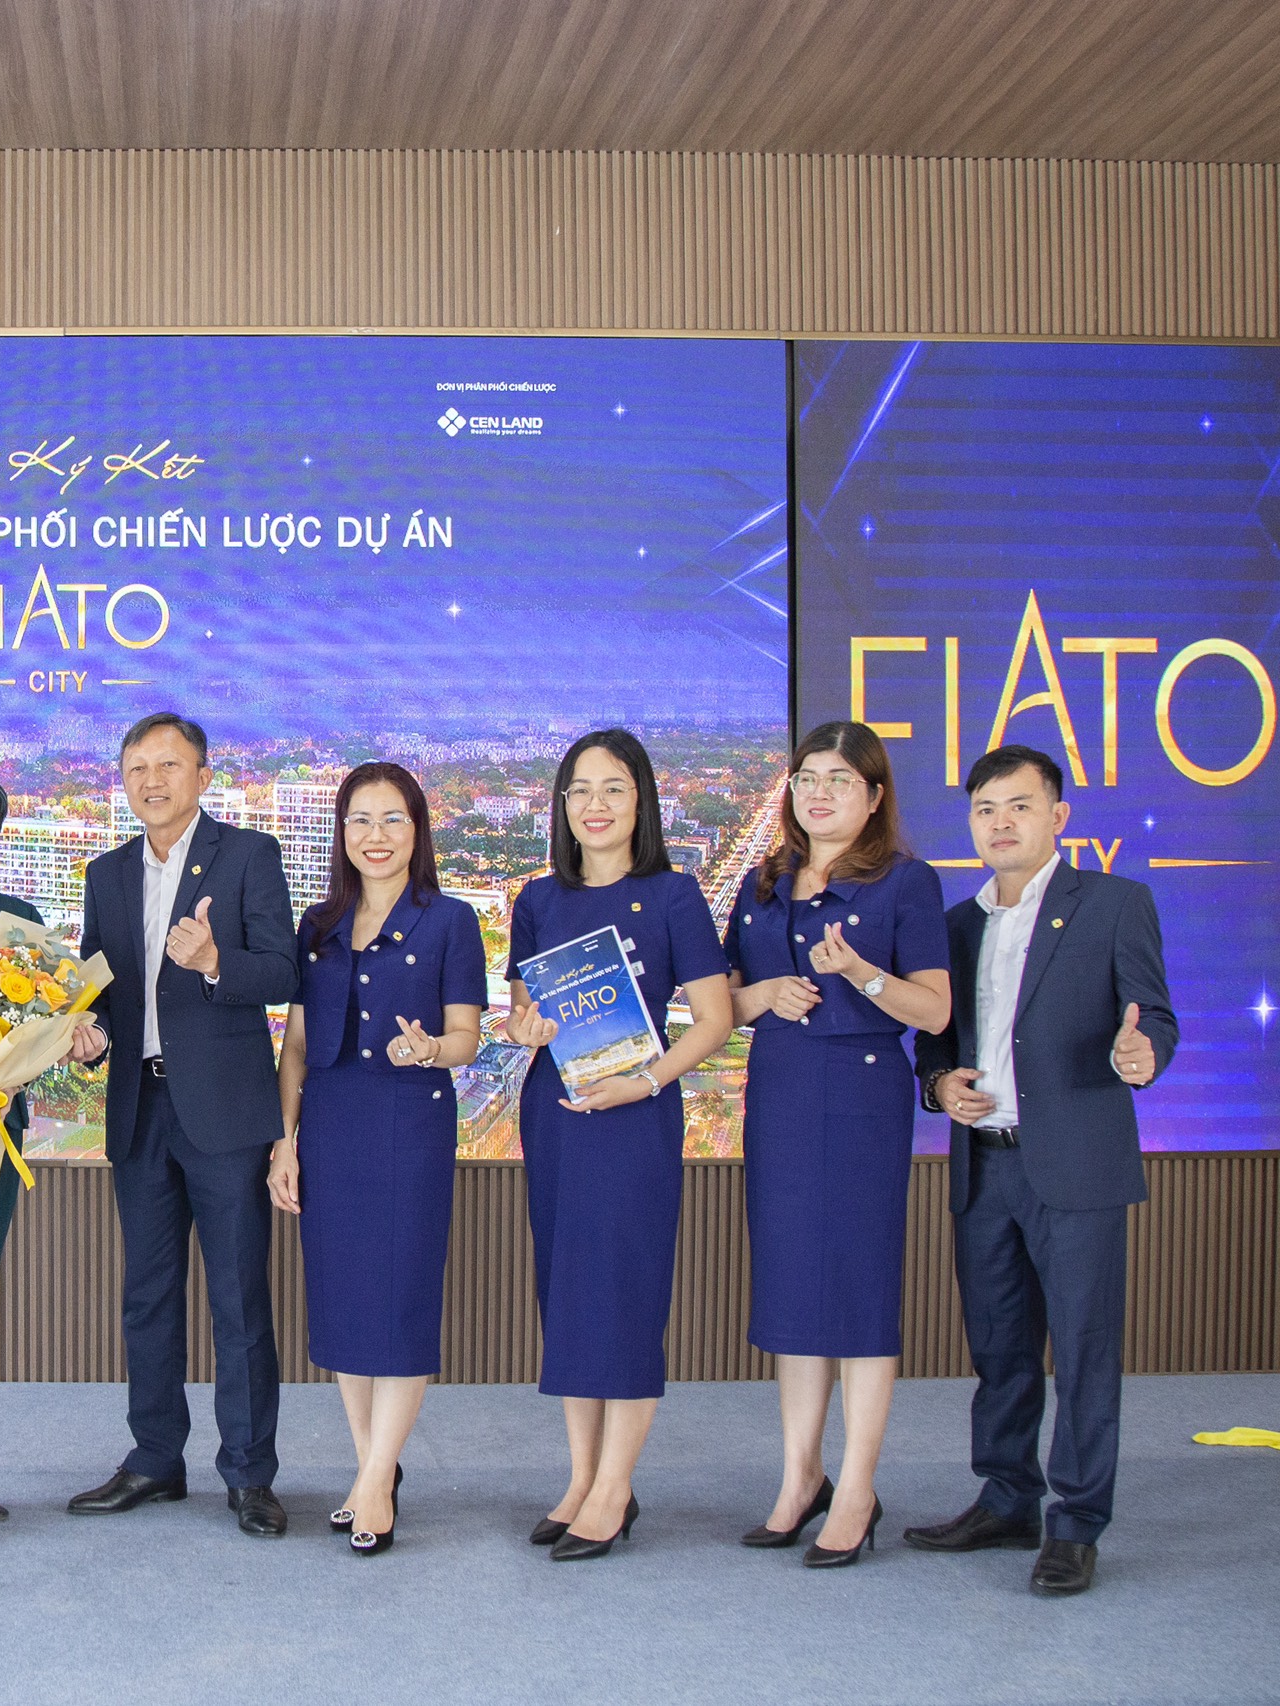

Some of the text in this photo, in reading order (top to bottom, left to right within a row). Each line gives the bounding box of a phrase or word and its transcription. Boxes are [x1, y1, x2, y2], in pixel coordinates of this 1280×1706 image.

[456, 383, 465, 393] VỊ
[465, 381, 487, 391] PHÂN
[488, 381, 508, 391] PHỐI
[508, 381, 533, 392] CHIẾN
[534, 383, 557, 394] LƯỢC
[469, 416, 544, 429] CEN LAND
[470, 428, 501, 436] Realizing
[517, 428, 542, 436] dreams
[8, 435, 93, 495] Ký
[103, 439, 205, 485] Kết
[92, 507, 207, 548] CHIẾN
[223, 512, 322, 554] LƯỢC
[337, 512, 391, 554] DỰ
[403, 509, 453, 548] ÁN
[29, 670, 88, 693] CITY
[850, 588, 1277, 787] FIATO
[558, 985, 617, 1023] FIATO
[586, 1013, 602, 1025] CITY
